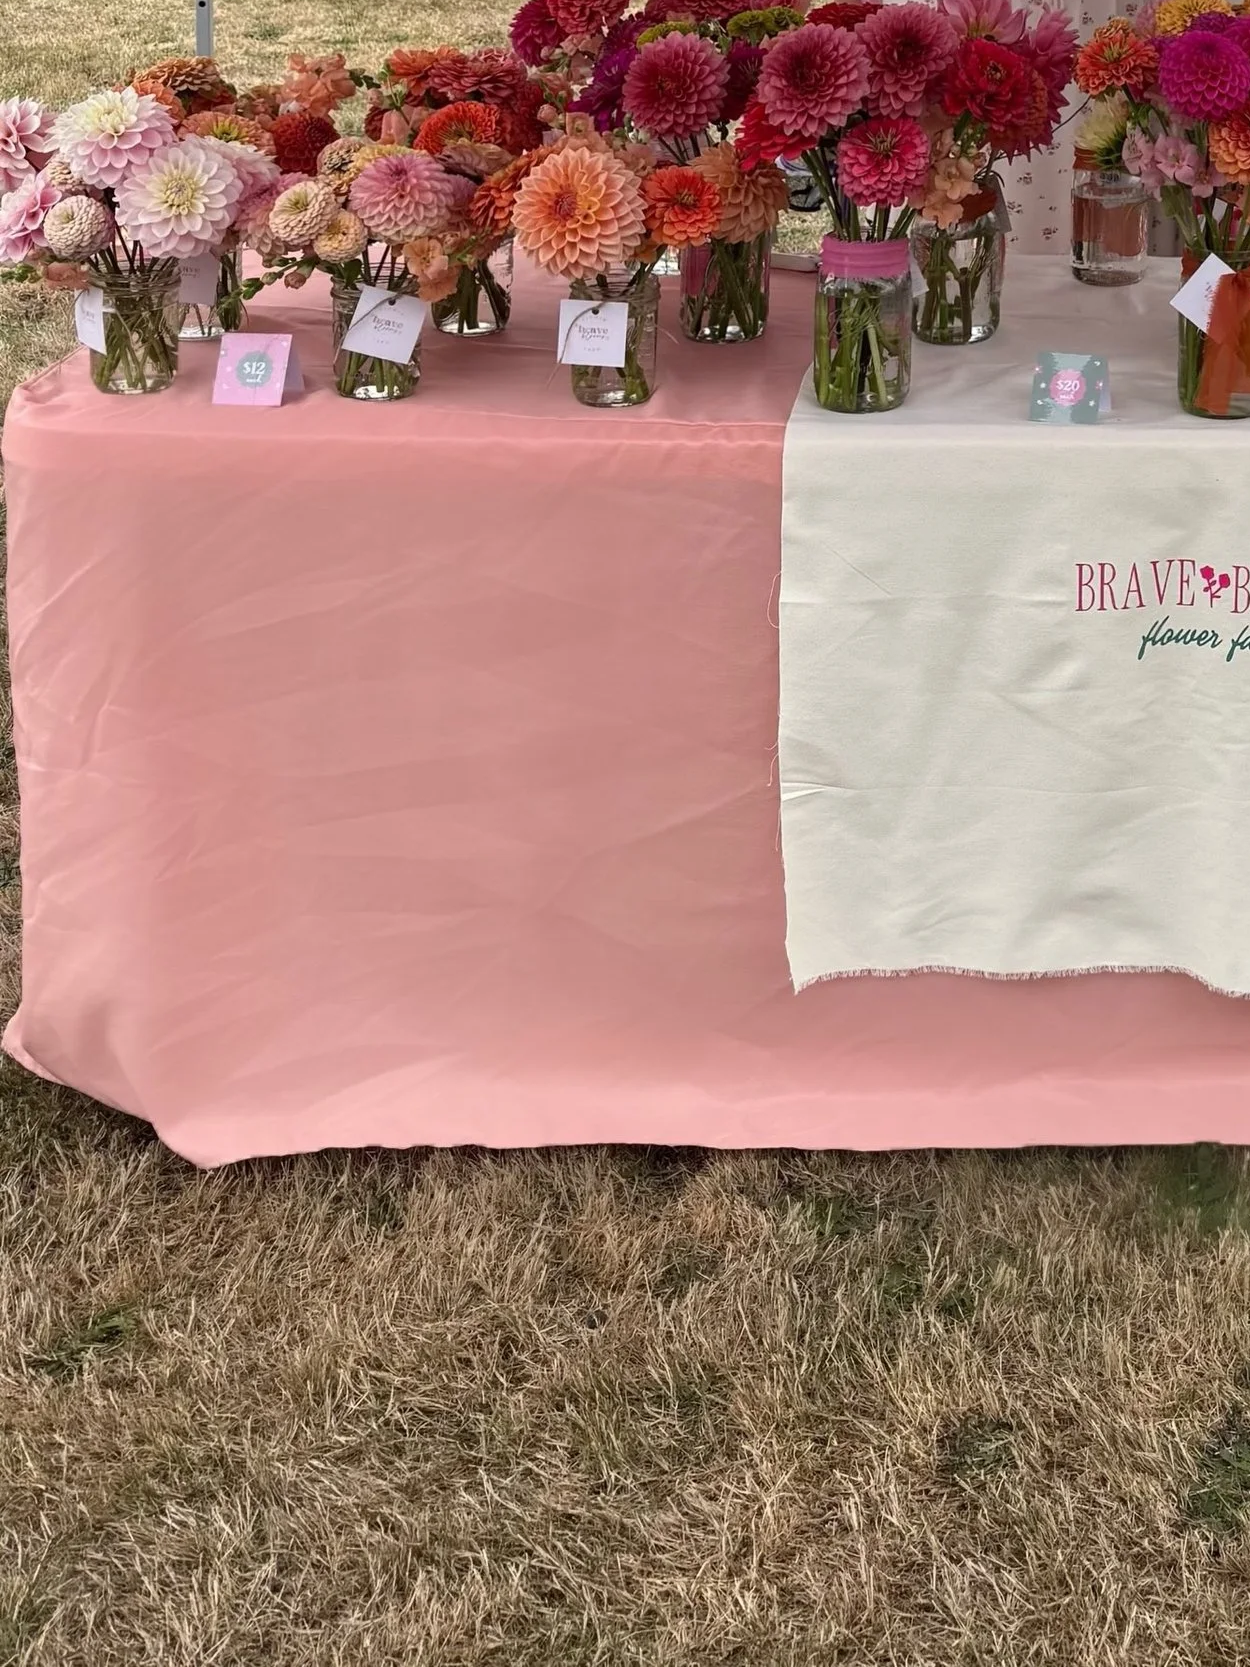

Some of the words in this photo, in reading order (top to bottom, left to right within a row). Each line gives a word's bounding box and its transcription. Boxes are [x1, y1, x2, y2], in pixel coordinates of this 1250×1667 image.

[243, 361, 266, 375] $12
[1056, 380, 1080, 392] $20
[1074, 559, 1196, 612] BRAVE
[1137, 615, 1223, 661] flower
